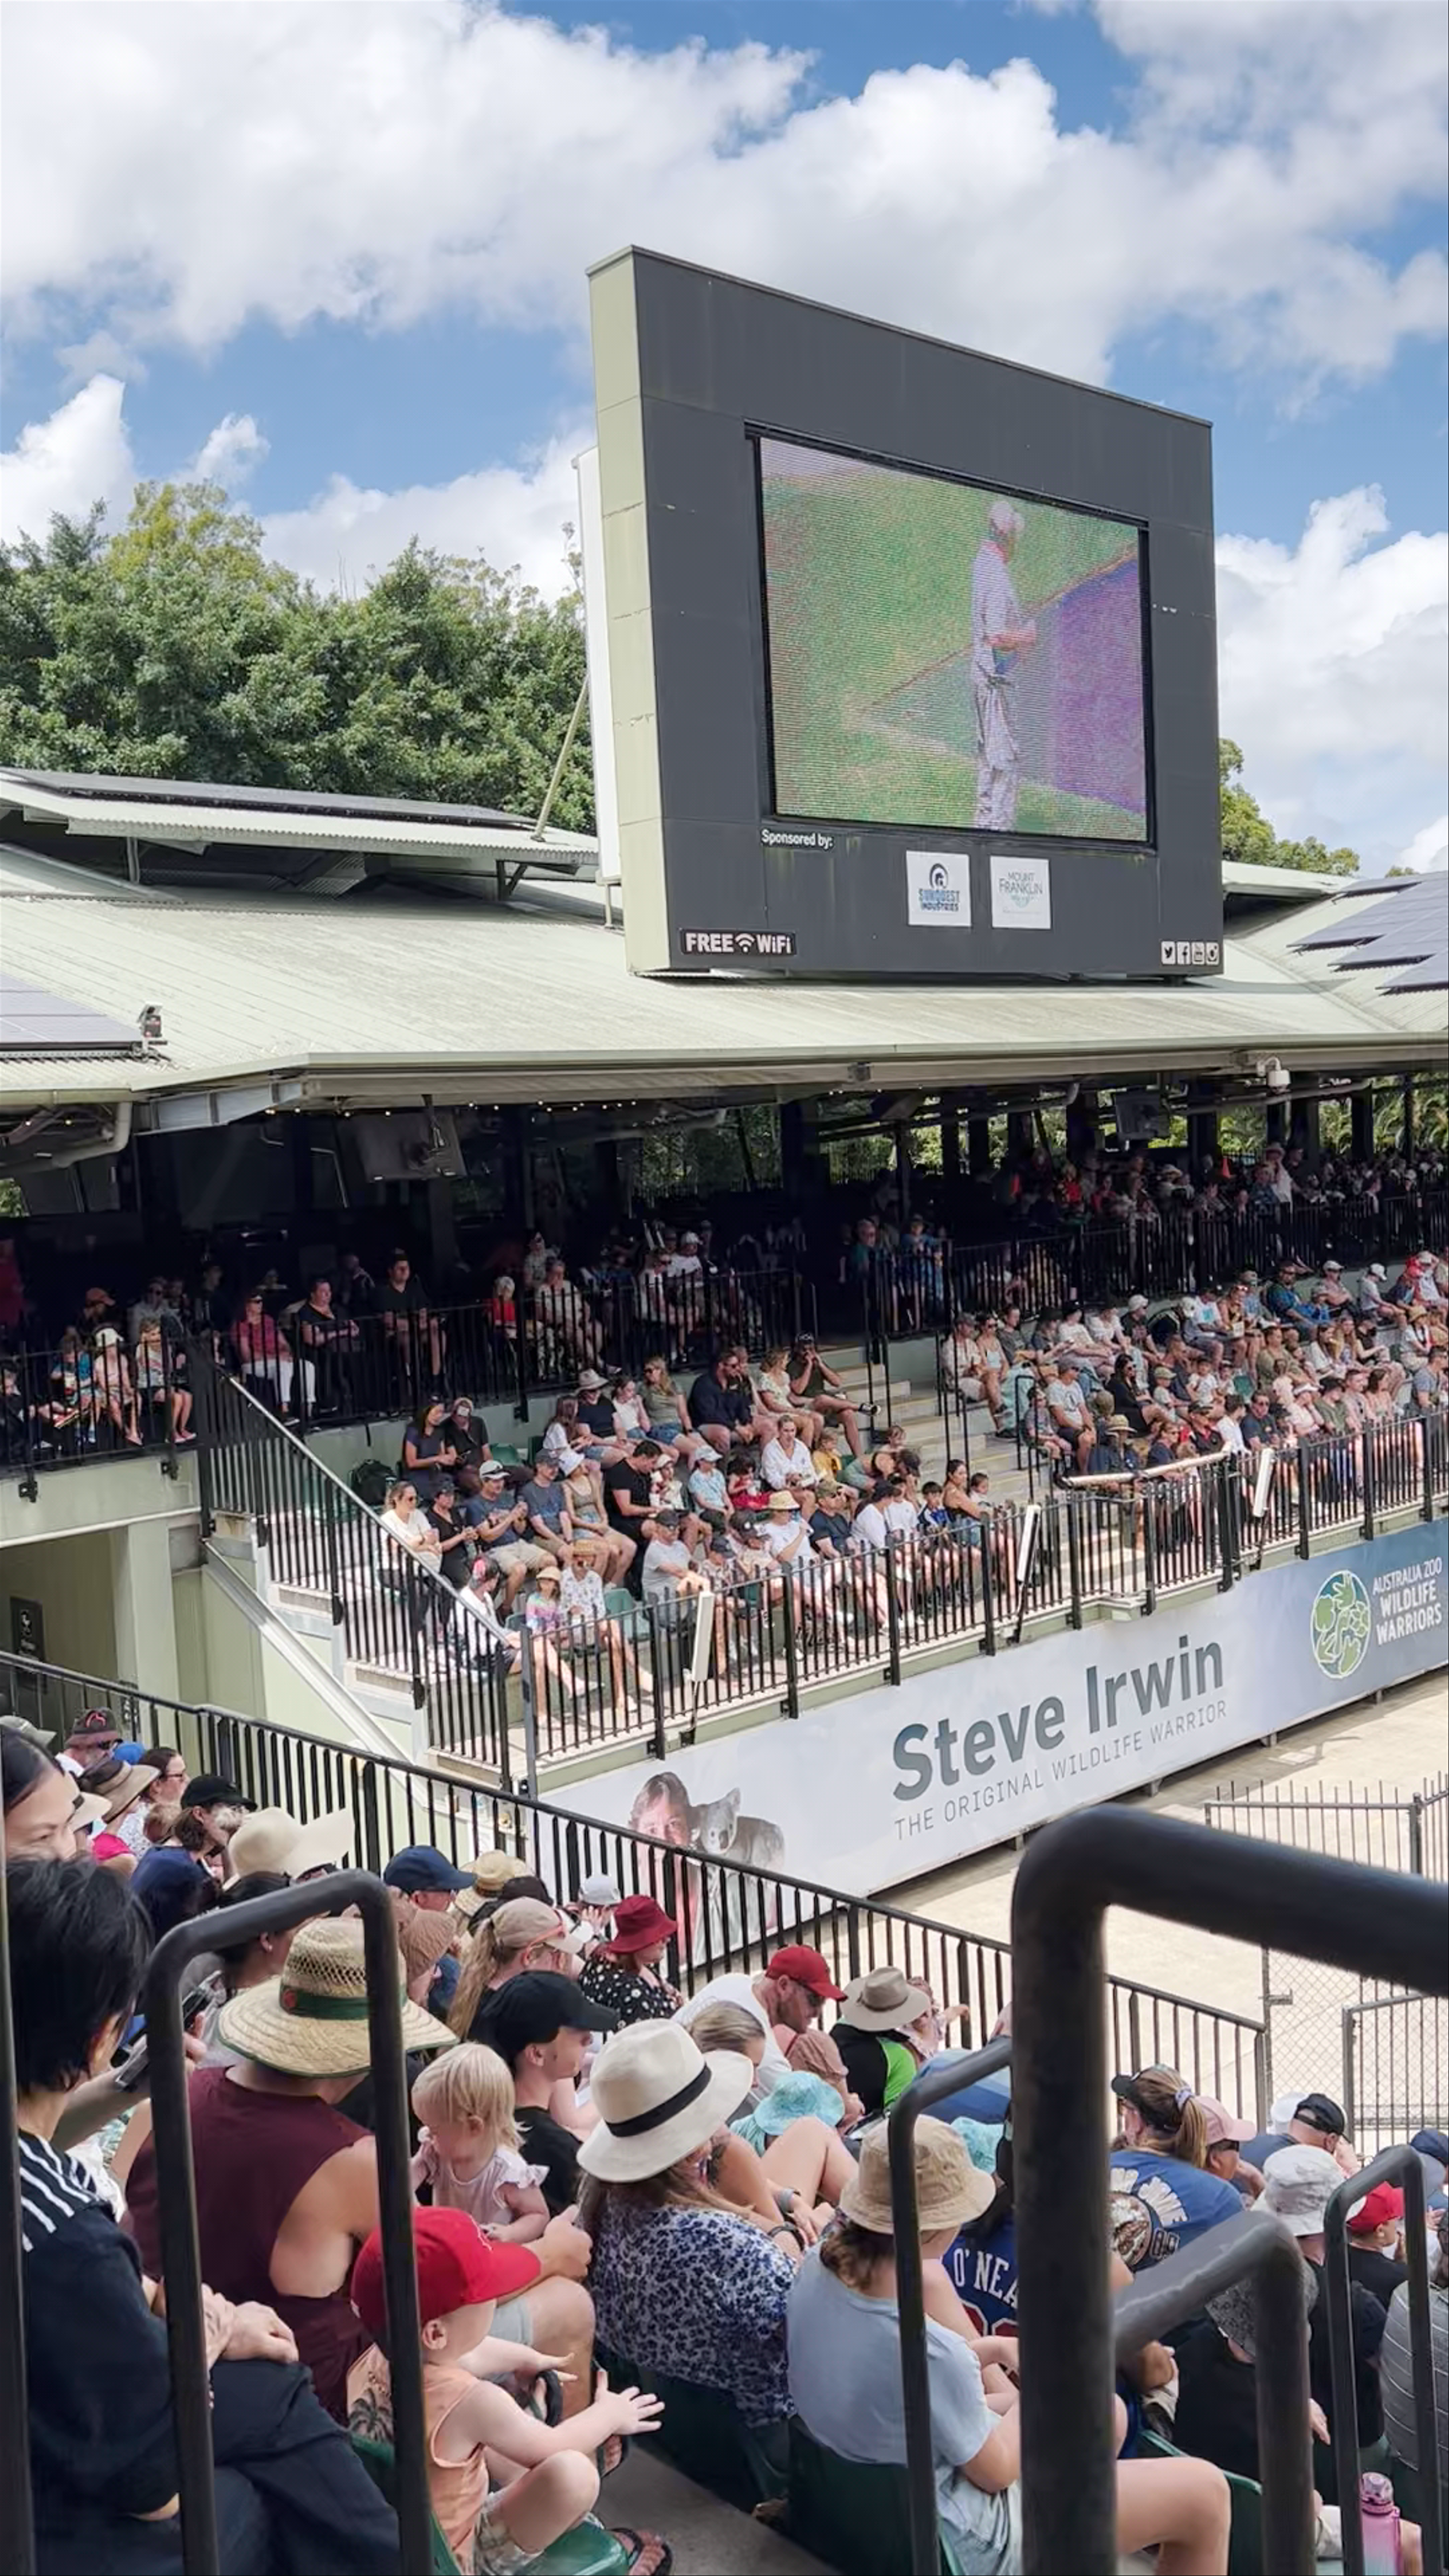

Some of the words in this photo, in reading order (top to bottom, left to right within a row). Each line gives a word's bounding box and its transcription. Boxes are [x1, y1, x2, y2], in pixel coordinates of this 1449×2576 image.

[761, 828, 815, 846] Sponsored
[818, 833, 833, 849] by:
[999, 878, 1043, 895] FRANKLIN
[1008, 872, 1035, 881] MOUNT
[686, 932, 734, 953] FREE
[756, 934, 792, 954] WiFi
[1373, 1564, 1422, 1595] AUSTRALIA
[1423, 1556, 1443, 1578] ZOO
[1380, 1579, 1437, 1618] WILDLIFE
[1376, 1603, 1442, 1645] WARRIORS
[892, 1695, 1066, 1801] Steve
[1086, 1635, 1223, 1734] Irwin
[894, 1807, 935, 1841] THE
[944, 1769, 1044, 1822] ORIGINAL
[1051, 1730, 1143, 1781] WILDLIFE
[1149, 1699, 1227, 1745] WARRIOR
[953, 2247, 1018, 2309] O'NEA
